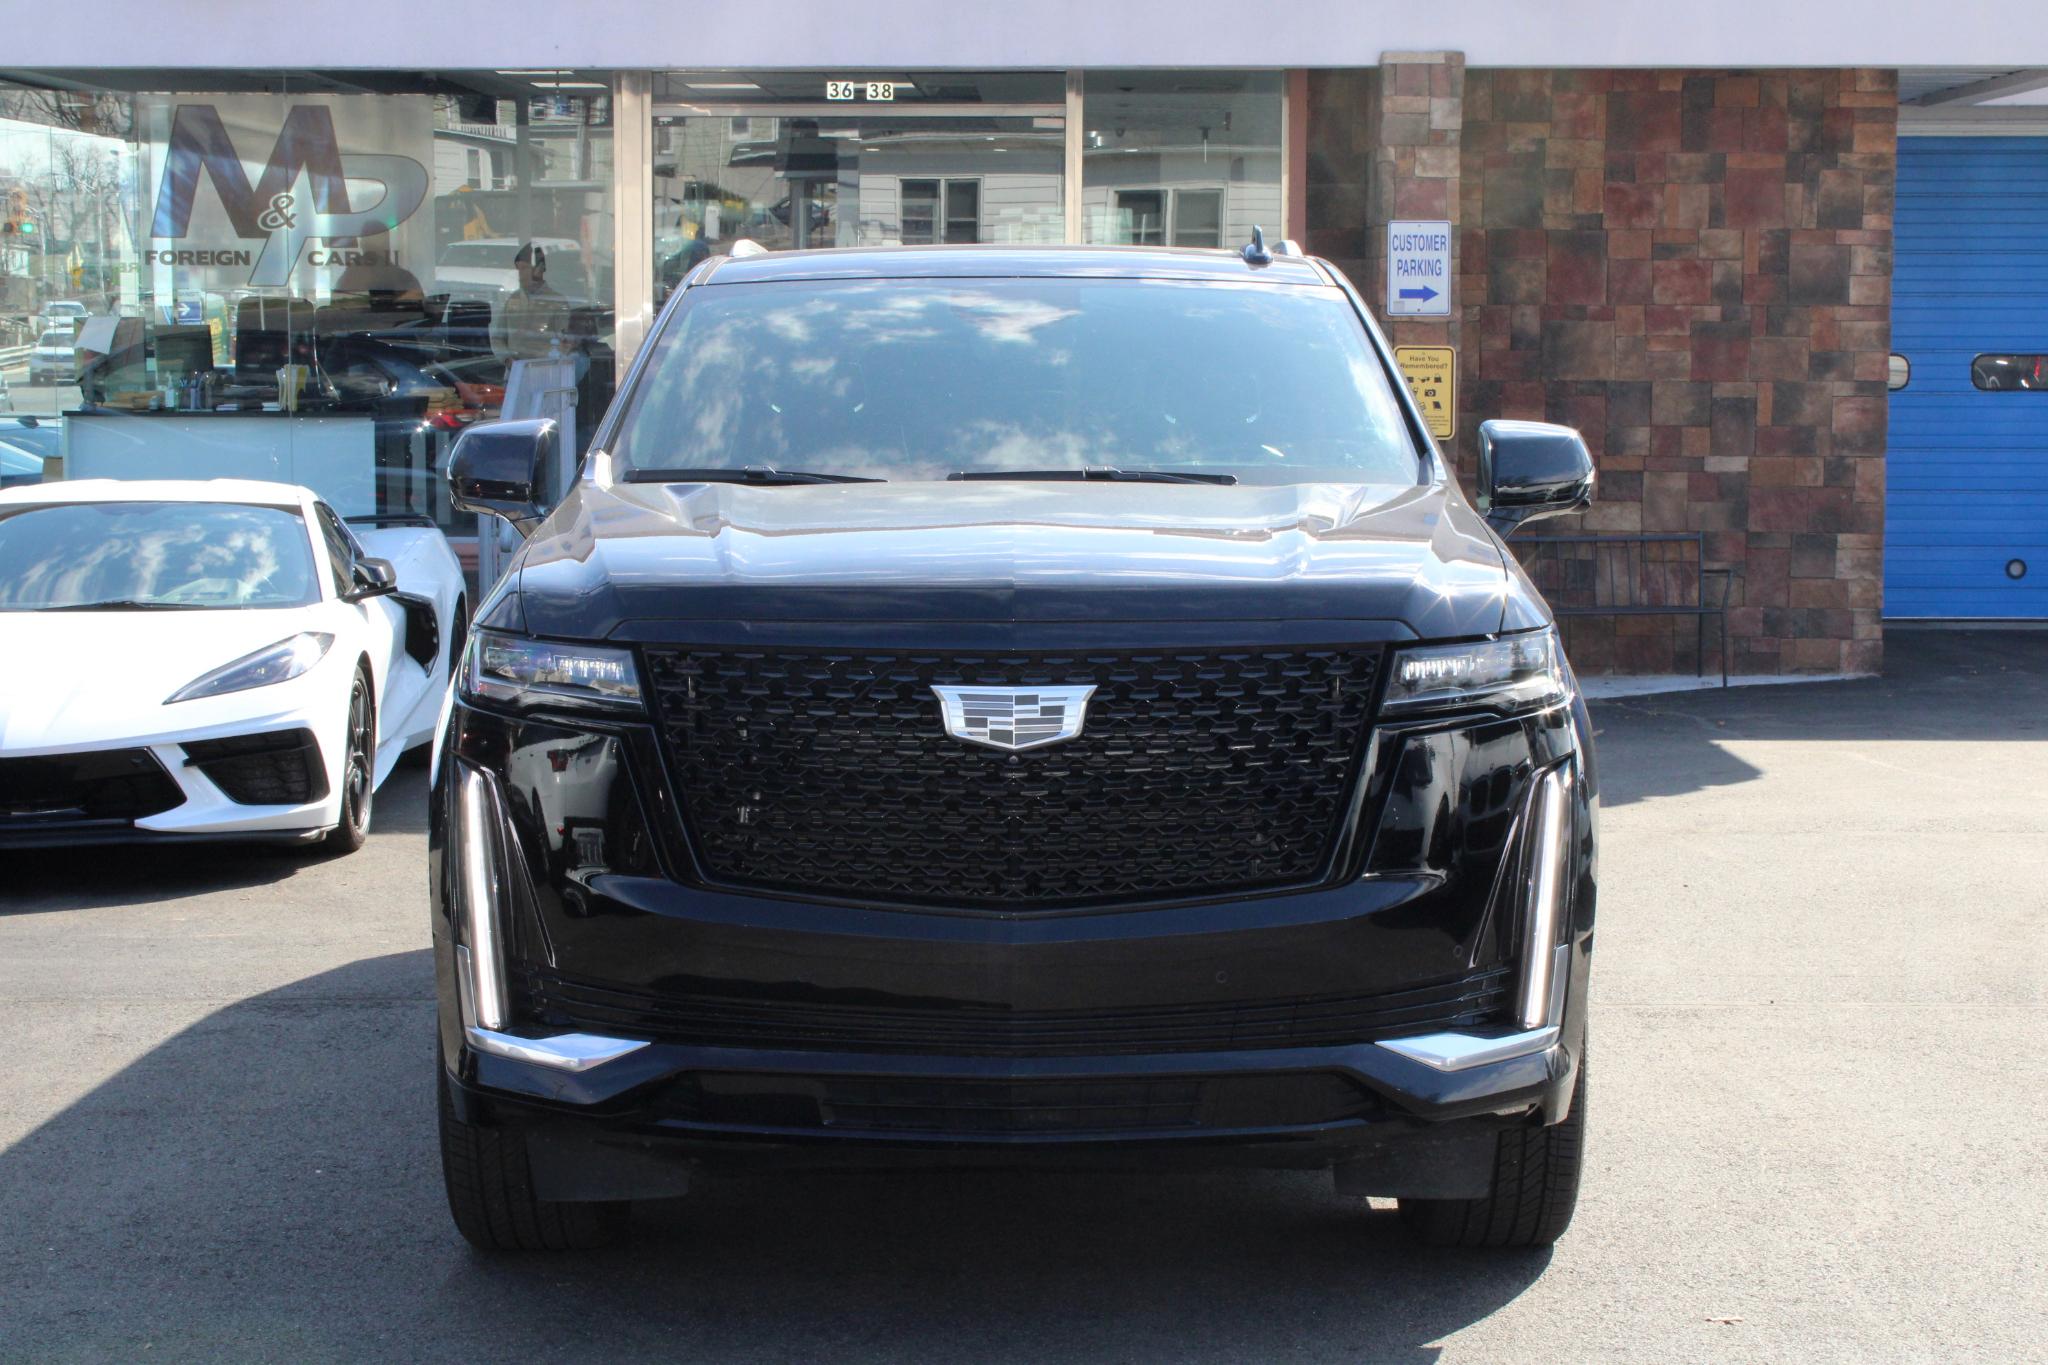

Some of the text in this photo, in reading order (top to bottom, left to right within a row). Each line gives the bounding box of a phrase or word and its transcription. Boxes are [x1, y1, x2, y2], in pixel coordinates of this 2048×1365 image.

[829, 82, 892, 99] 36 38
[1392, 234, 1447, 251] CUSTOMER
[144, 250, 250, 266] FOREIGN
[307, 250, 378, 266] CARS
[1397, 259, 1442, 276] PARKING
